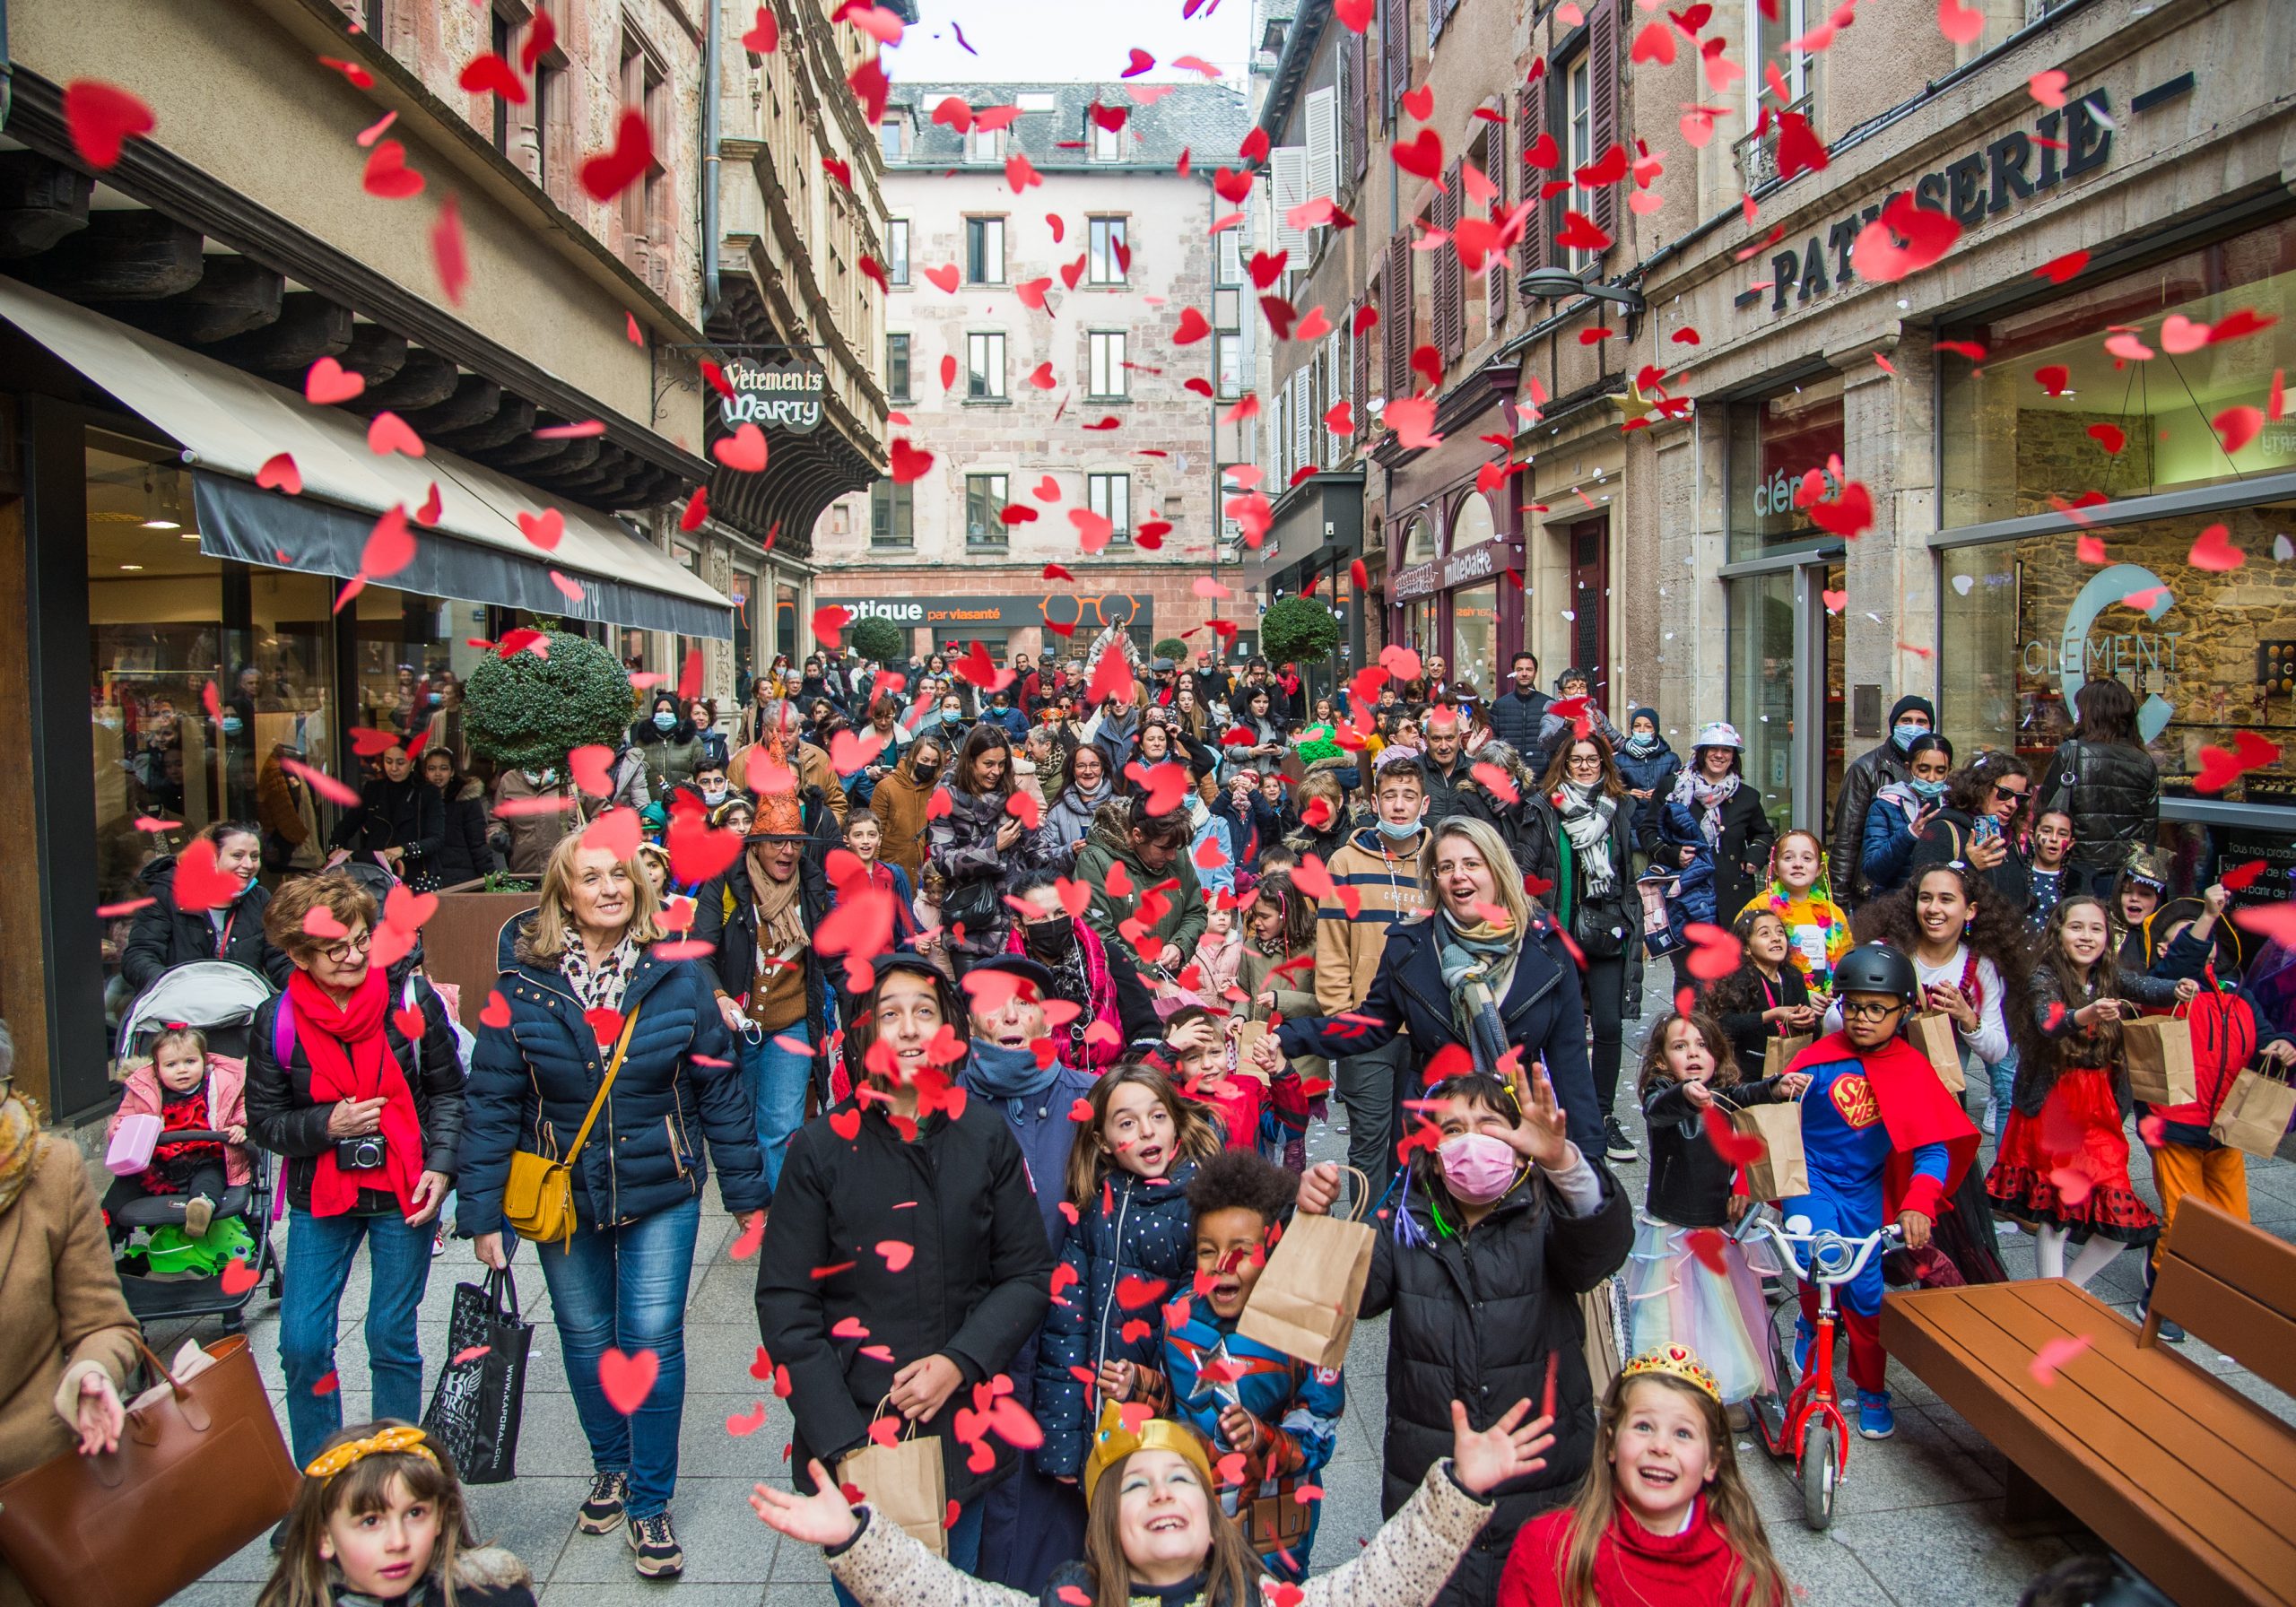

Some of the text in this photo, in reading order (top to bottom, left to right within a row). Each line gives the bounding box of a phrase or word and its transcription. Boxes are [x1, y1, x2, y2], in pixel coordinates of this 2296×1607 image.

[1771, 87, 2112, 311] PATSERIE
[827, 600, 1001, 625] ptique par viasanté
[2023, 625, 2182, 675] CLÉMENT
[2228, 842, 2296, 860] Tous nos produ
[2224, 863, 2236, 872] sur
[2266, 867, 2280, 878] de
[2248, 885, 2270, 896] partir
[2273, 888, 2286, 899] de
[491, 1363, 514, 1469] WWW.KAPORAL.COM
